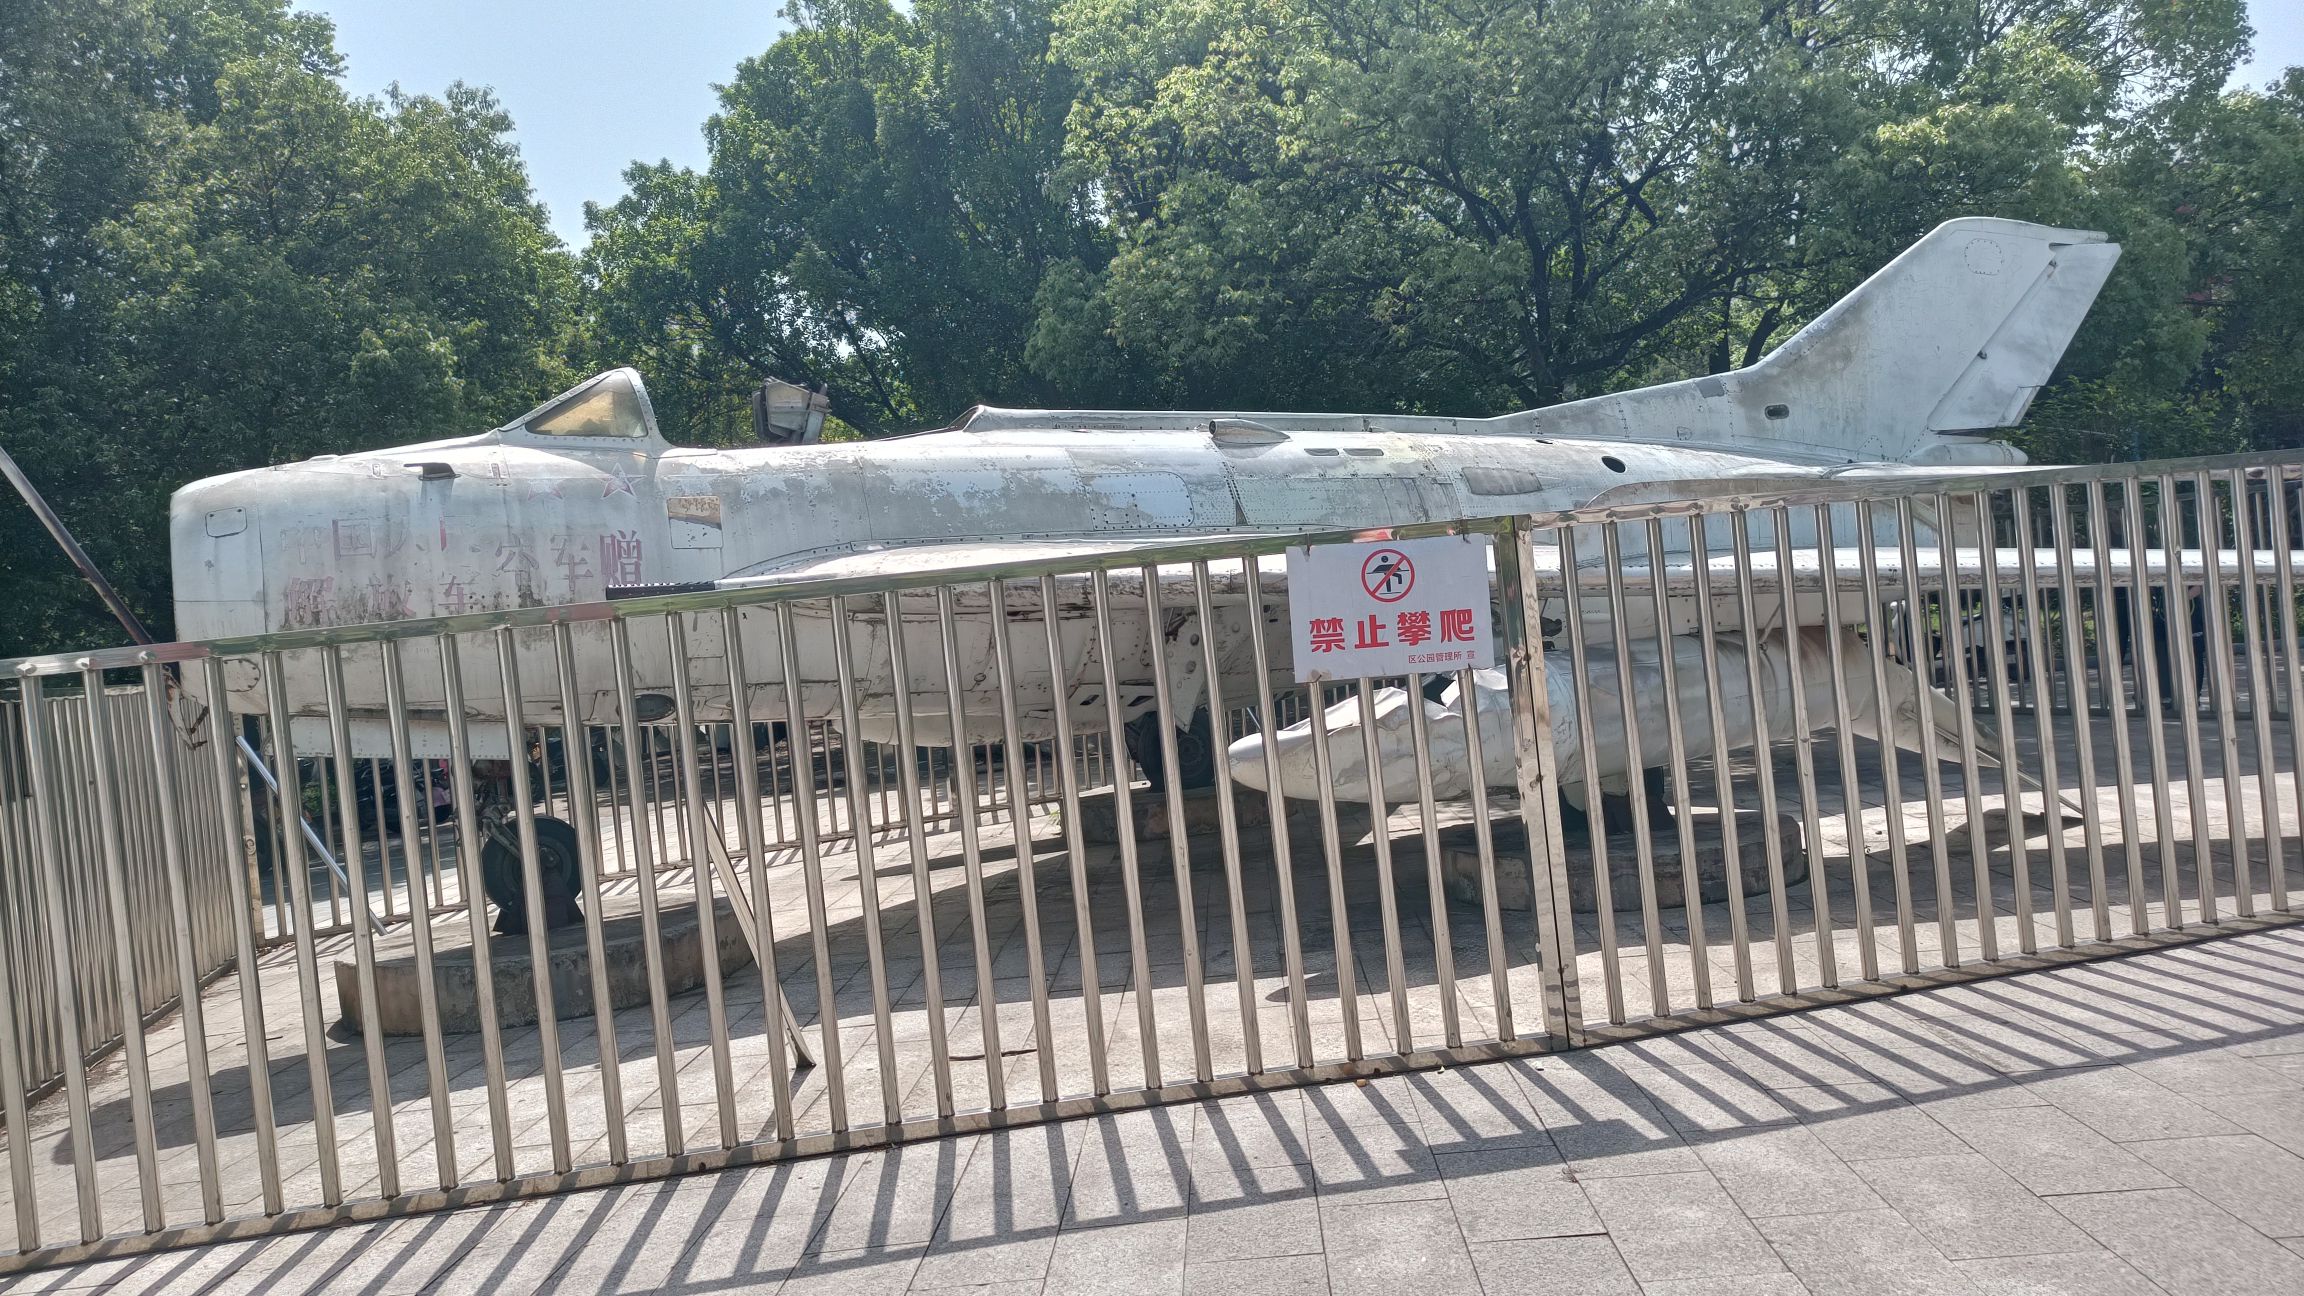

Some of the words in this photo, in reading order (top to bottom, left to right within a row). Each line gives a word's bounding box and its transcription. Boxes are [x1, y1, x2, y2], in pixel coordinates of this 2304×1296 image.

[1309, 608, 1475, 653] 禁止攀爬
[1408, 651, 1462, 664] 区公园管理所
